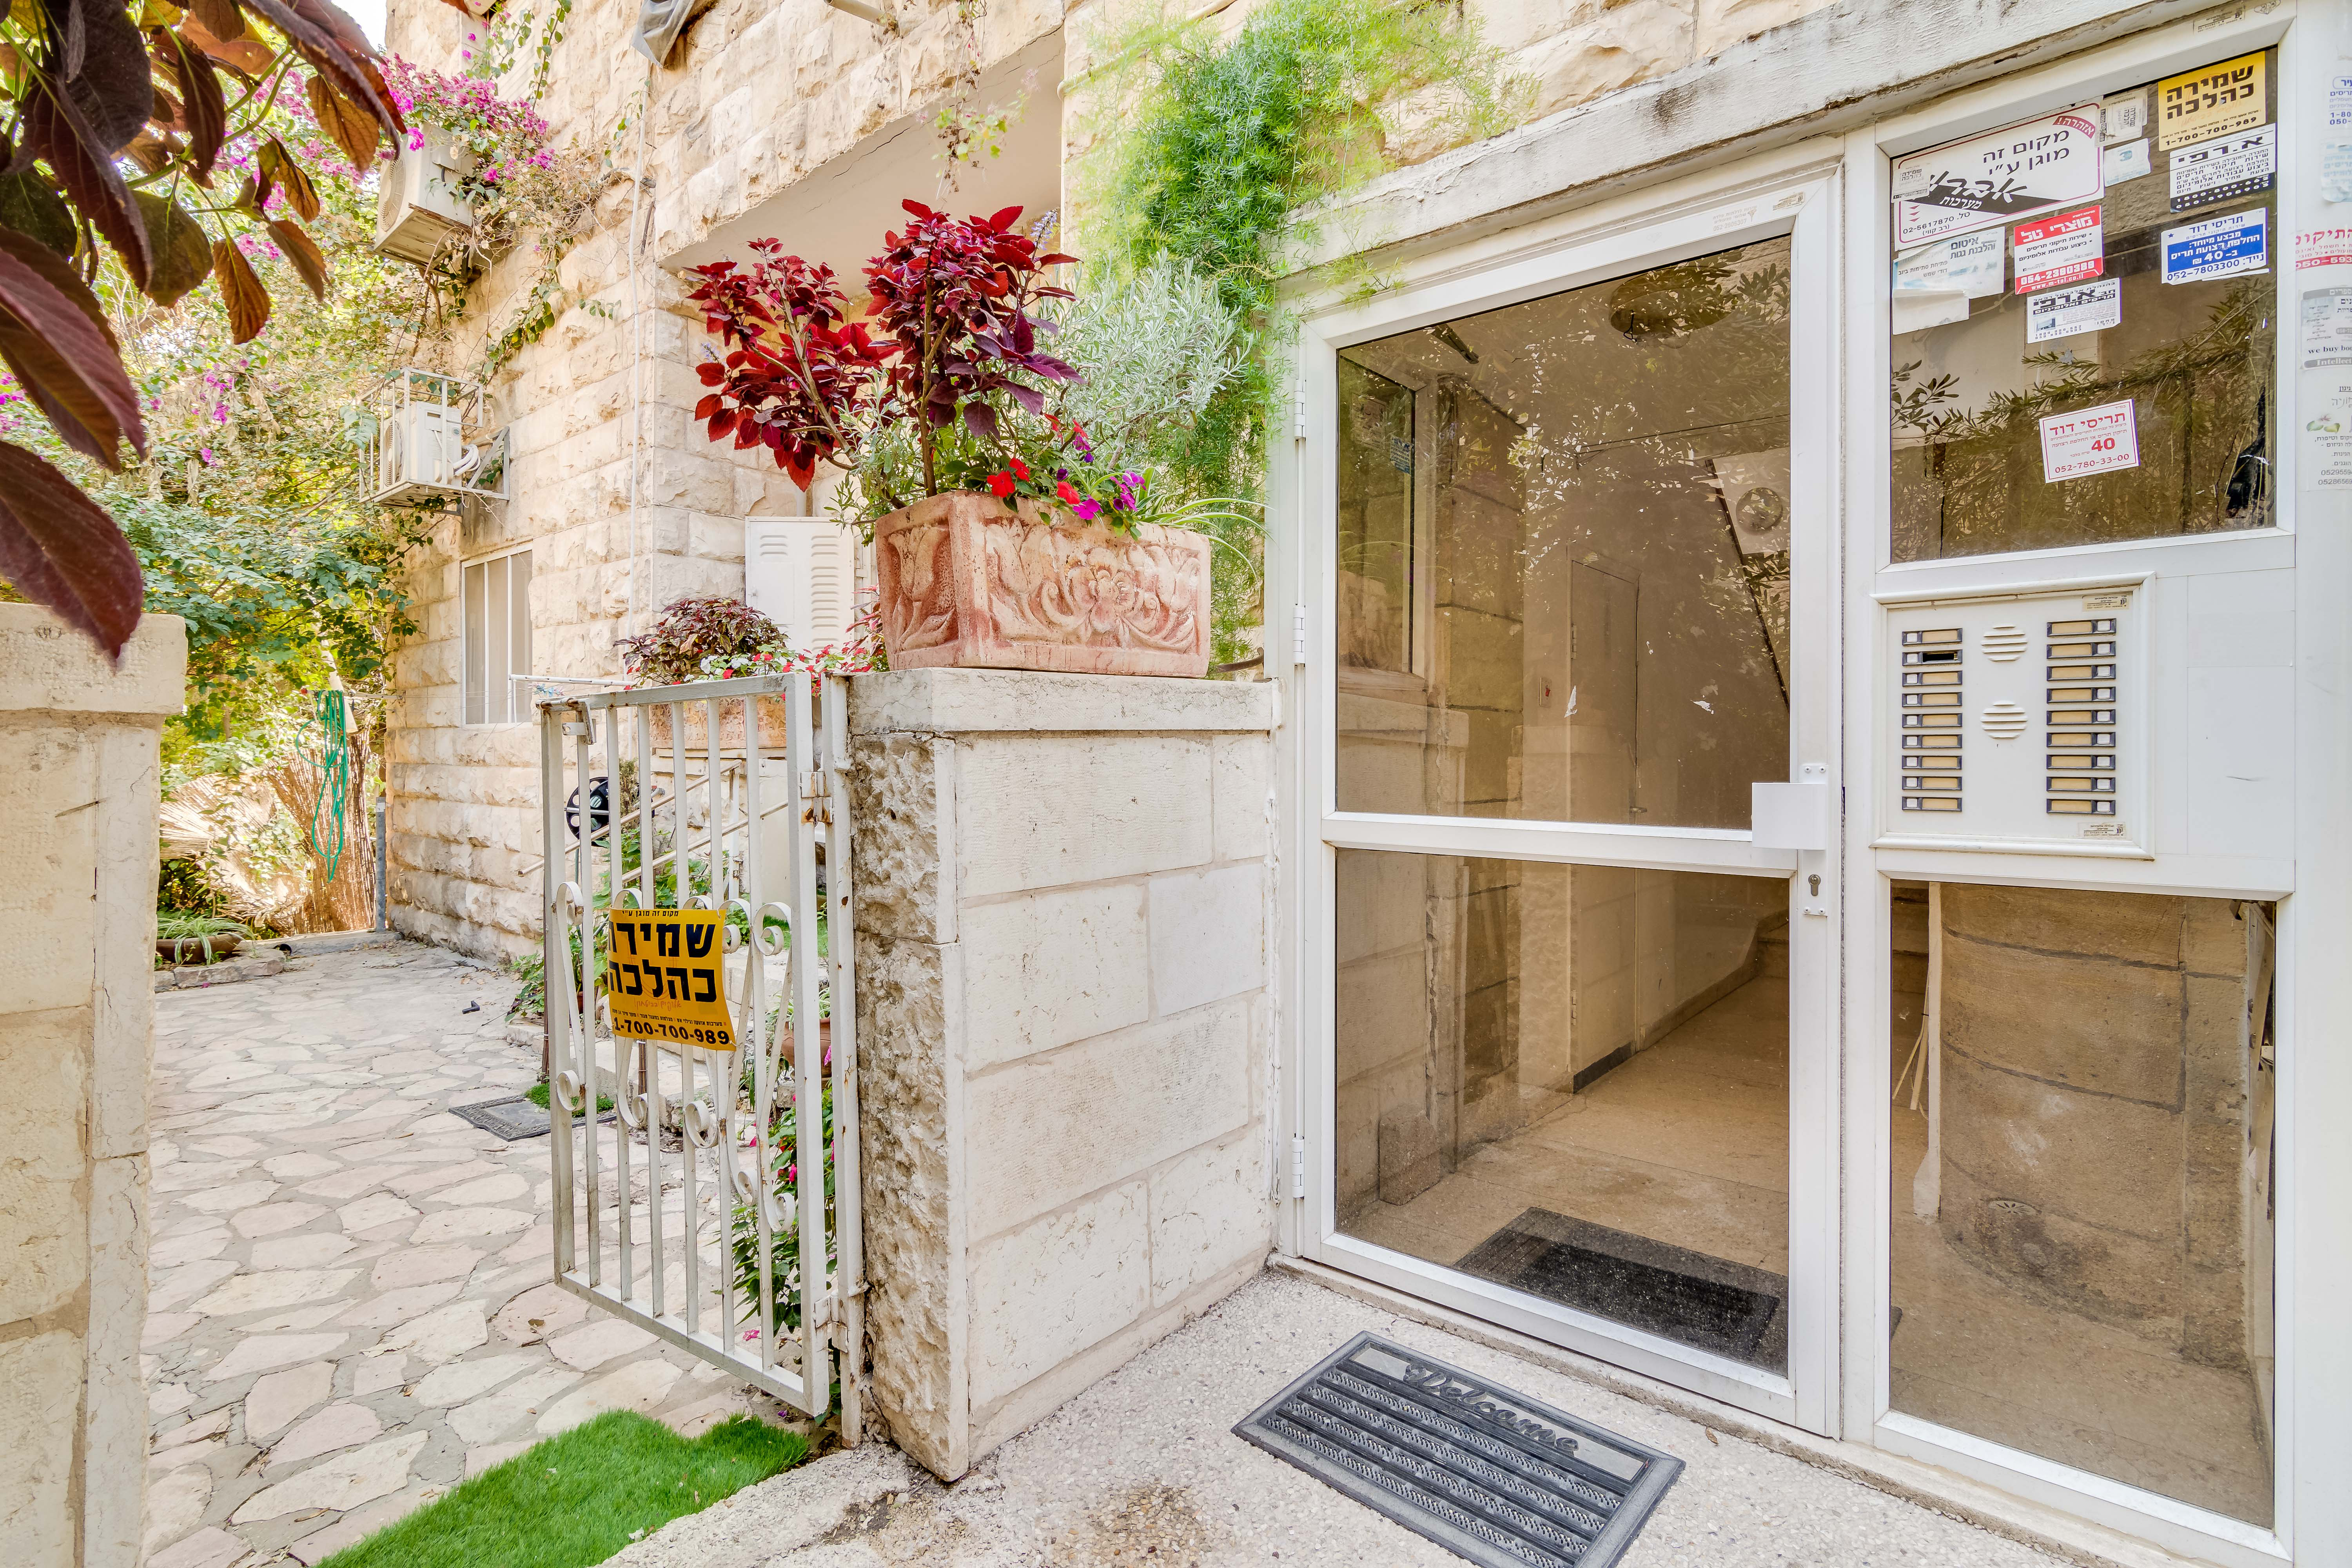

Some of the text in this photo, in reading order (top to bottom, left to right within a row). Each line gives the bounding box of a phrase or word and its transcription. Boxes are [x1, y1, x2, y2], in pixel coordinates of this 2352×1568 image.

[2167, 65, 2254, 103] שמירה
[2167, 82, 2254, 120] כהלכה
[2058, 117, 2095, 136] אזהרה!
[2165, 116, 2257, 146] 1-700-700-989
[1983, 130, 2069, 163] מקום זה
[2178, 136, 2264, 163] א.רפי
[2029, 148, 2069, 170] מוגן
[2176, 149, 2269, 176] החברה המובילה בשירות ואמינות
[2177, 152, 2269, 180] שירות תיקוני תריסים
[2247, 158, 2269, 166] החלפת
[2177, 162, 2269, 189] ביצוע עבודות אלומיניום
[2202, 171, 2221, 179] לתריס
[2250, 167, 2269, 176] הצעת
[1939, 196, 1982, 210] מערכות
[1902, 216, 1954, 234] 02-5617870
[2020, 216, 2093, 243] מוצרי טל
[2189, 215, 2243, 234] תריסי דוד
[1951, 237, 1978, 250] איטום
[2069, 233, 2087, 241] שירות
[2186, 232, 2206, 240] תריסים
[2189, 231, 2241, 248] מבצע מיוחד:
[1968, 243, 1995, 256] והלבנת
[2019, 241, 2087, 262] ביצוע עבודות אלומיניום
[2026, 243, 2047, 252] תריסים
[2171, 234, 2260, 260] החלפת רצועת תריס
[2203, 250, 2223, 262] 40
[1910, 265, 1929, 273] סתימות
[1930, 260, 1948, 270] פתיחת
[2167, 253, 2264, 281] נייד: 052-7803300
[2049, 412, 2125, 436] תריסי דוד
[2091, 437, 2115, 452] 40
[2055, 454, 2129, 473] 052-780-33-00
[608, 920, 716, 958] שמירה
[608, 959, 717, 1003] כהלכה
[614, 1016, 730, 1045] 1-700-700-989
[1403, 1363, 1579, 1453] Welcome
